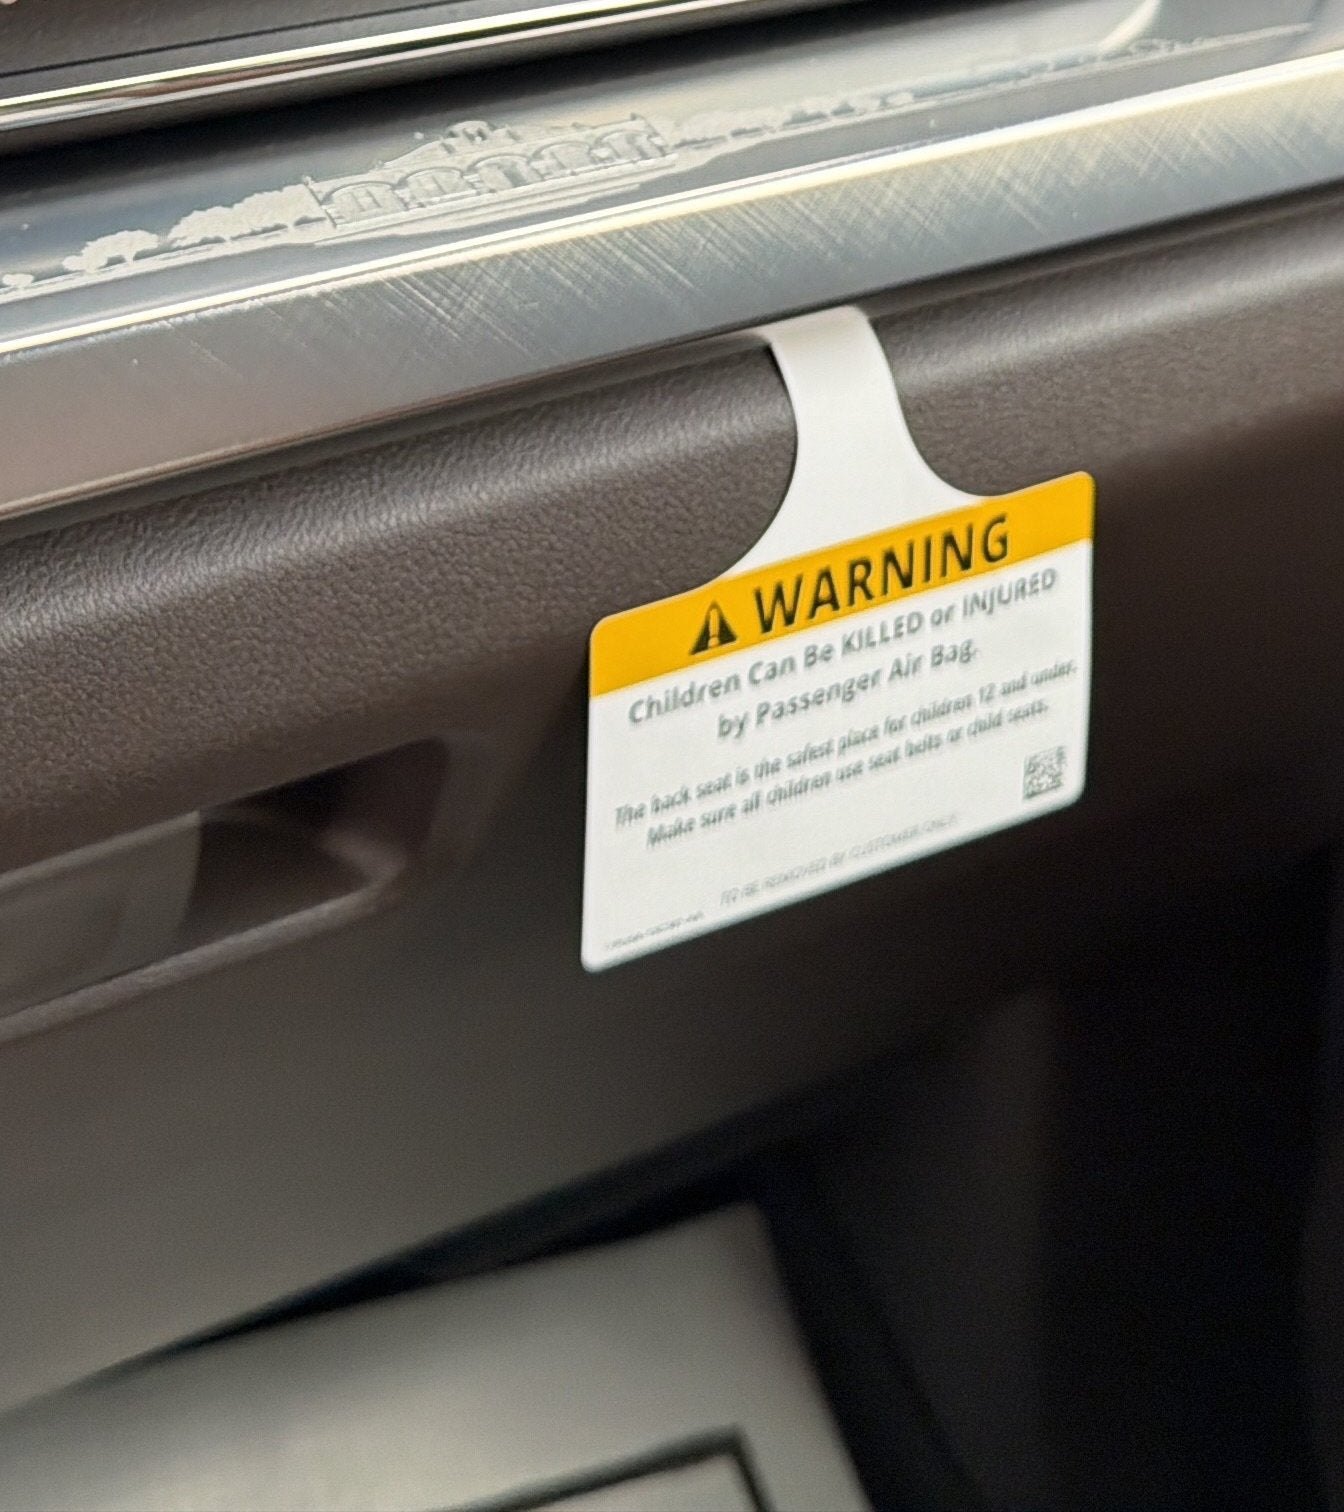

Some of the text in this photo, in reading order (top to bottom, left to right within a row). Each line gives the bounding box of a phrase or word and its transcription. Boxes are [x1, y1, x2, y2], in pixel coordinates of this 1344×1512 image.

[628, 567, 1058, 724] Children Can Be KILLED or INJURED
[754, 513, 1008, 634] WARNING
[614, 802, 647, 828] The
[650, 786, 691, 816] back
[695, 773, 733, 800] seat
[735, 765, 751, 785] is
[753, 756, 783, 780] the
[837, 724, 880, 756] place
[883, 714, 907, 737] for
[910, 694, 974, 726] children
[978, 681, 997, 704] 12
[999, 671, 1029, 696] and
[1030, 659, 1078, 686] under.
[717, 638, 979, 739] by Passenger Air Bag.
[645, 698, 1050, 849] Make sure all children use seat belts or child seats.
